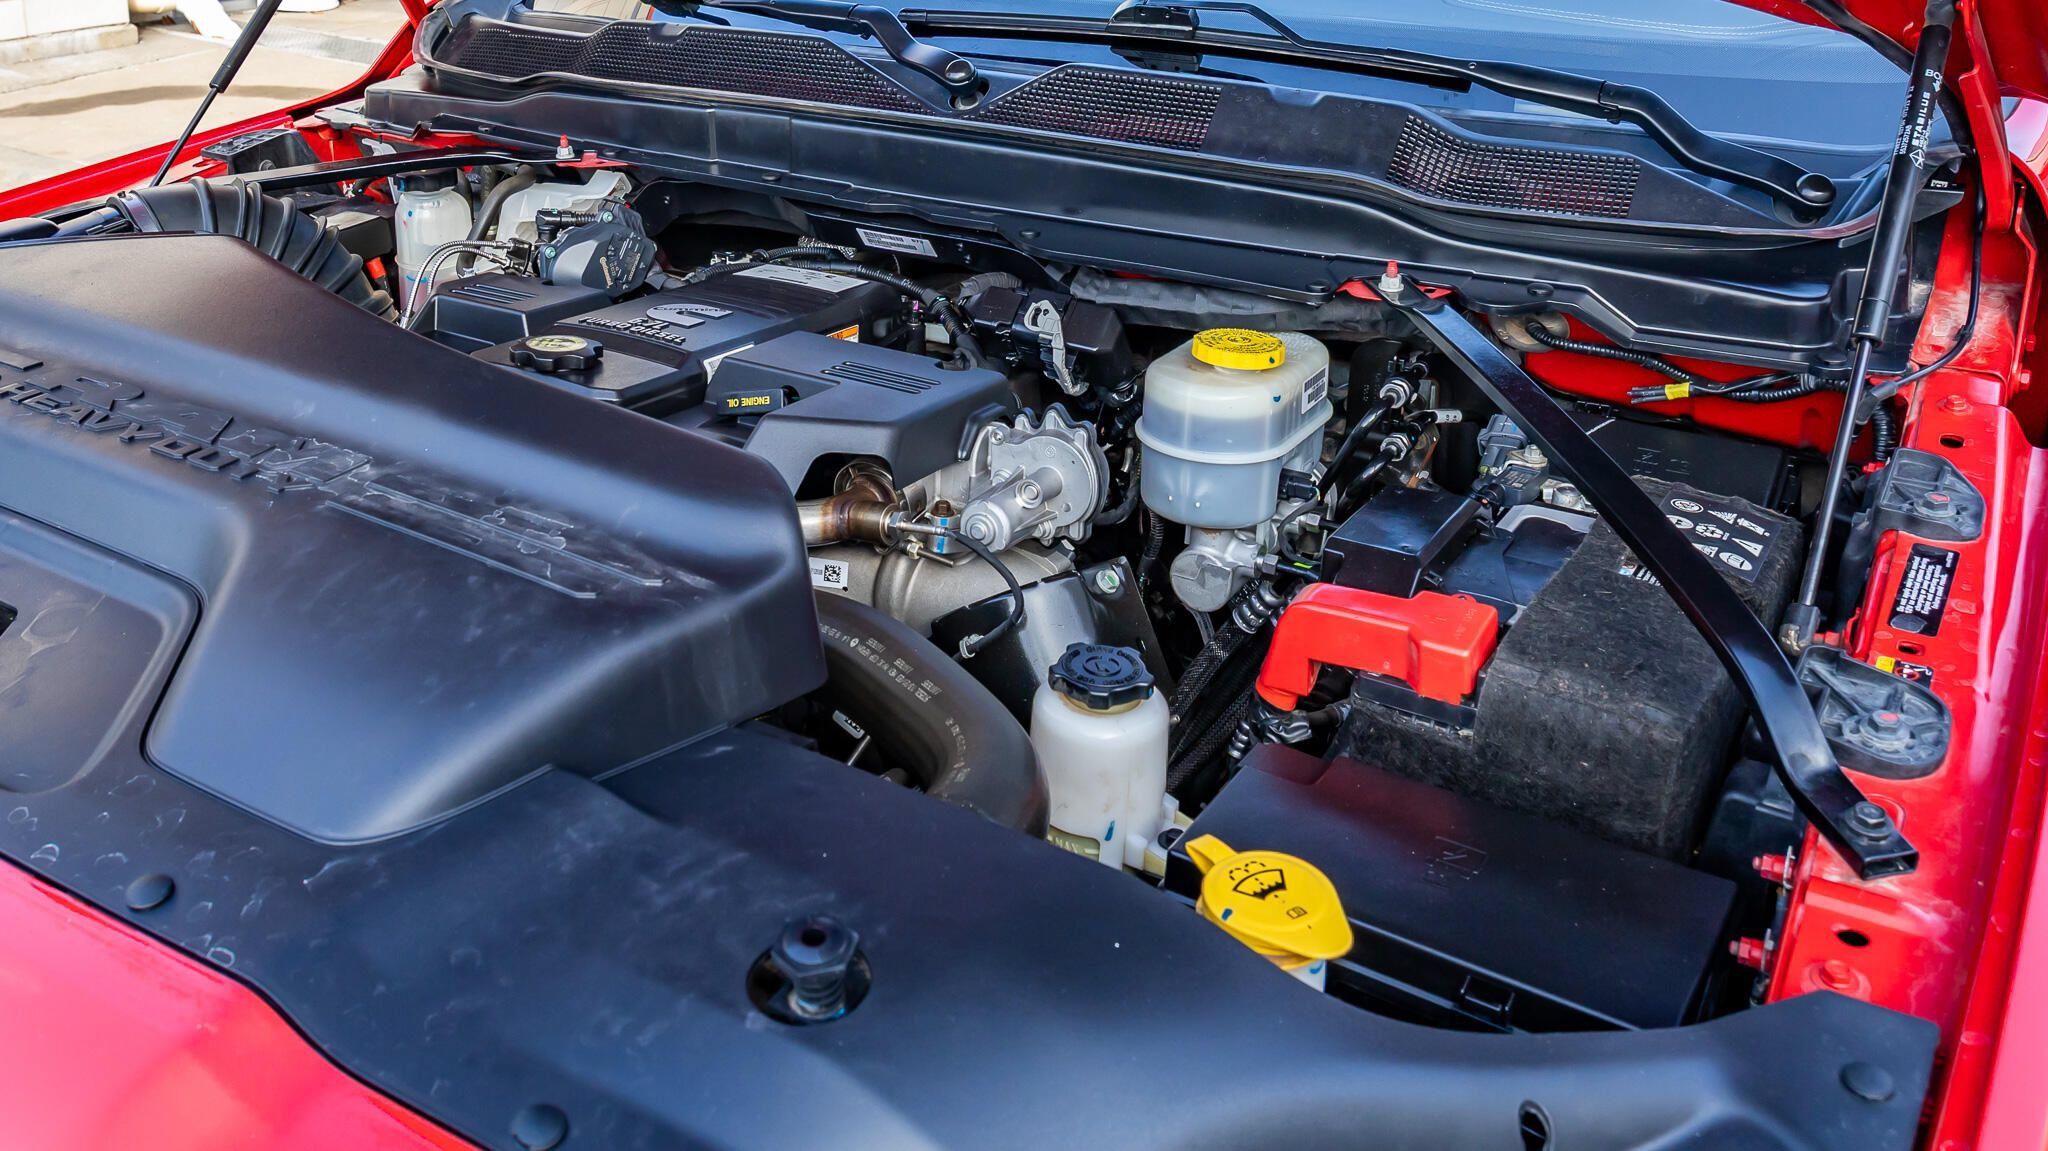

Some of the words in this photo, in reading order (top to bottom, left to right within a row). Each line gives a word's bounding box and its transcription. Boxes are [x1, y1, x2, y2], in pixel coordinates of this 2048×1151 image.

[1911, 91, 1931, 146] STABILUS
[628, 316, 670, 331] 6.7L
[578, 316, 629, 332] TURBO
[628, 323, 687, 347] DIESEL
[726, 398, 739, 408] OIL
[740, 395, 770, 407] ENGINE
